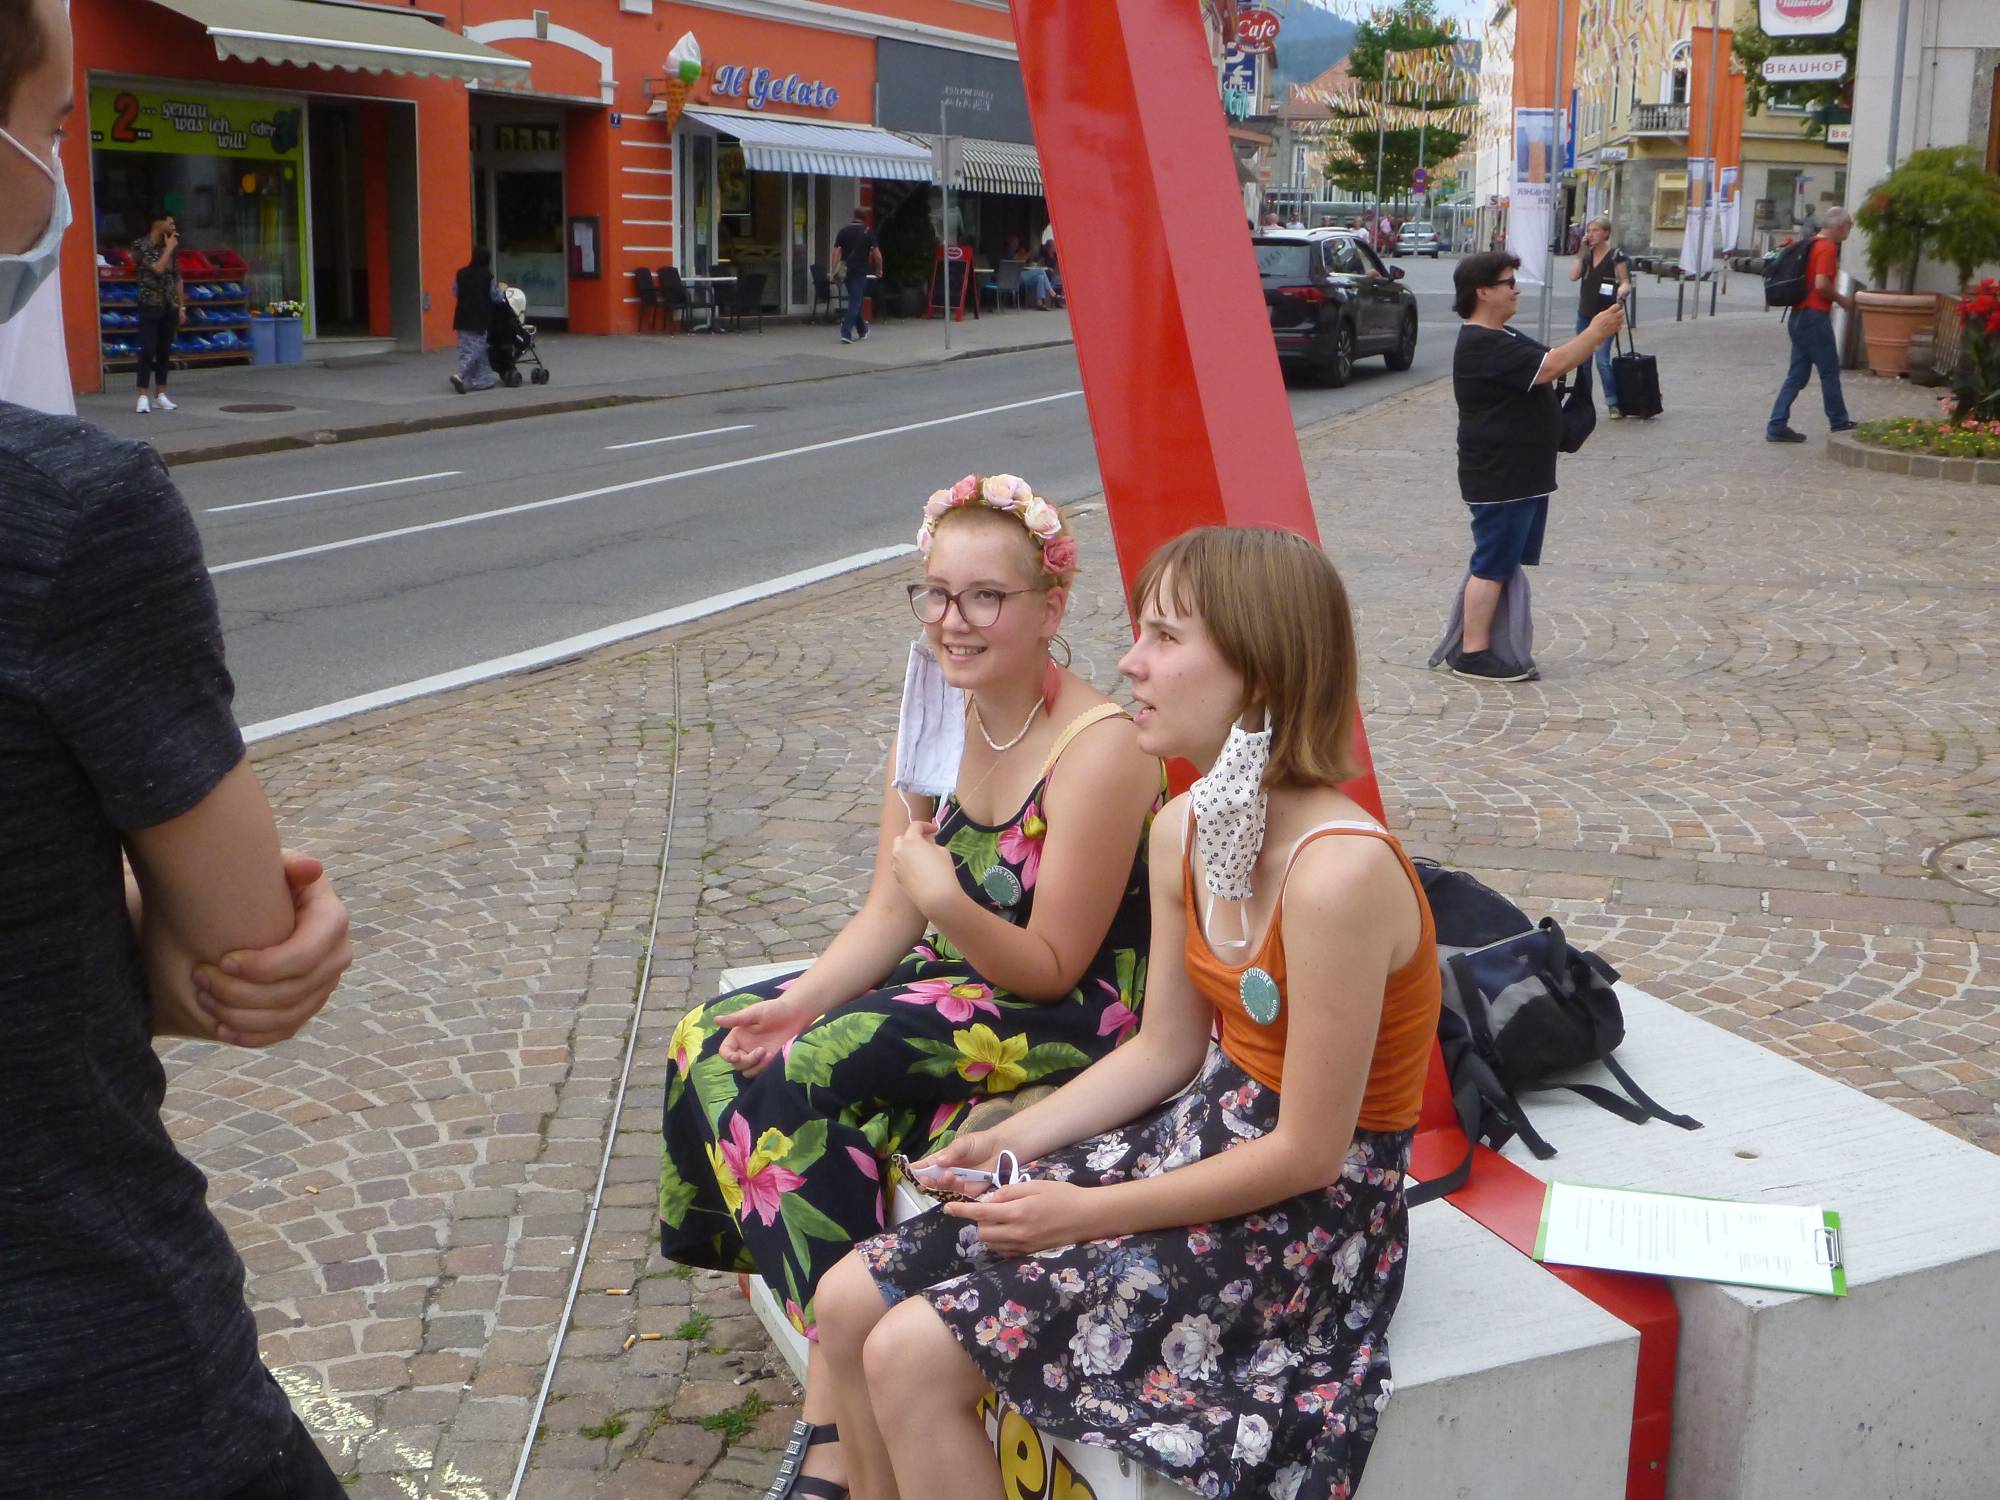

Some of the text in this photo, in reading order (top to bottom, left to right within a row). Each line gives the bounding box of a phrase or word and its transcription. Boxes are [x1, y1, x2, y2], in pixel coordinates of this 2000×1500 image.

[1765, 60, 1844, 75] BRAUHOF
[711, 64, 840, 110] Il Gelato
[161, 102, 209, 120] genau
[175, 117, 231, 134] was ich
[217, 132, 248, 149] will!
[1248, 967, 1273, 988] FUTURE
